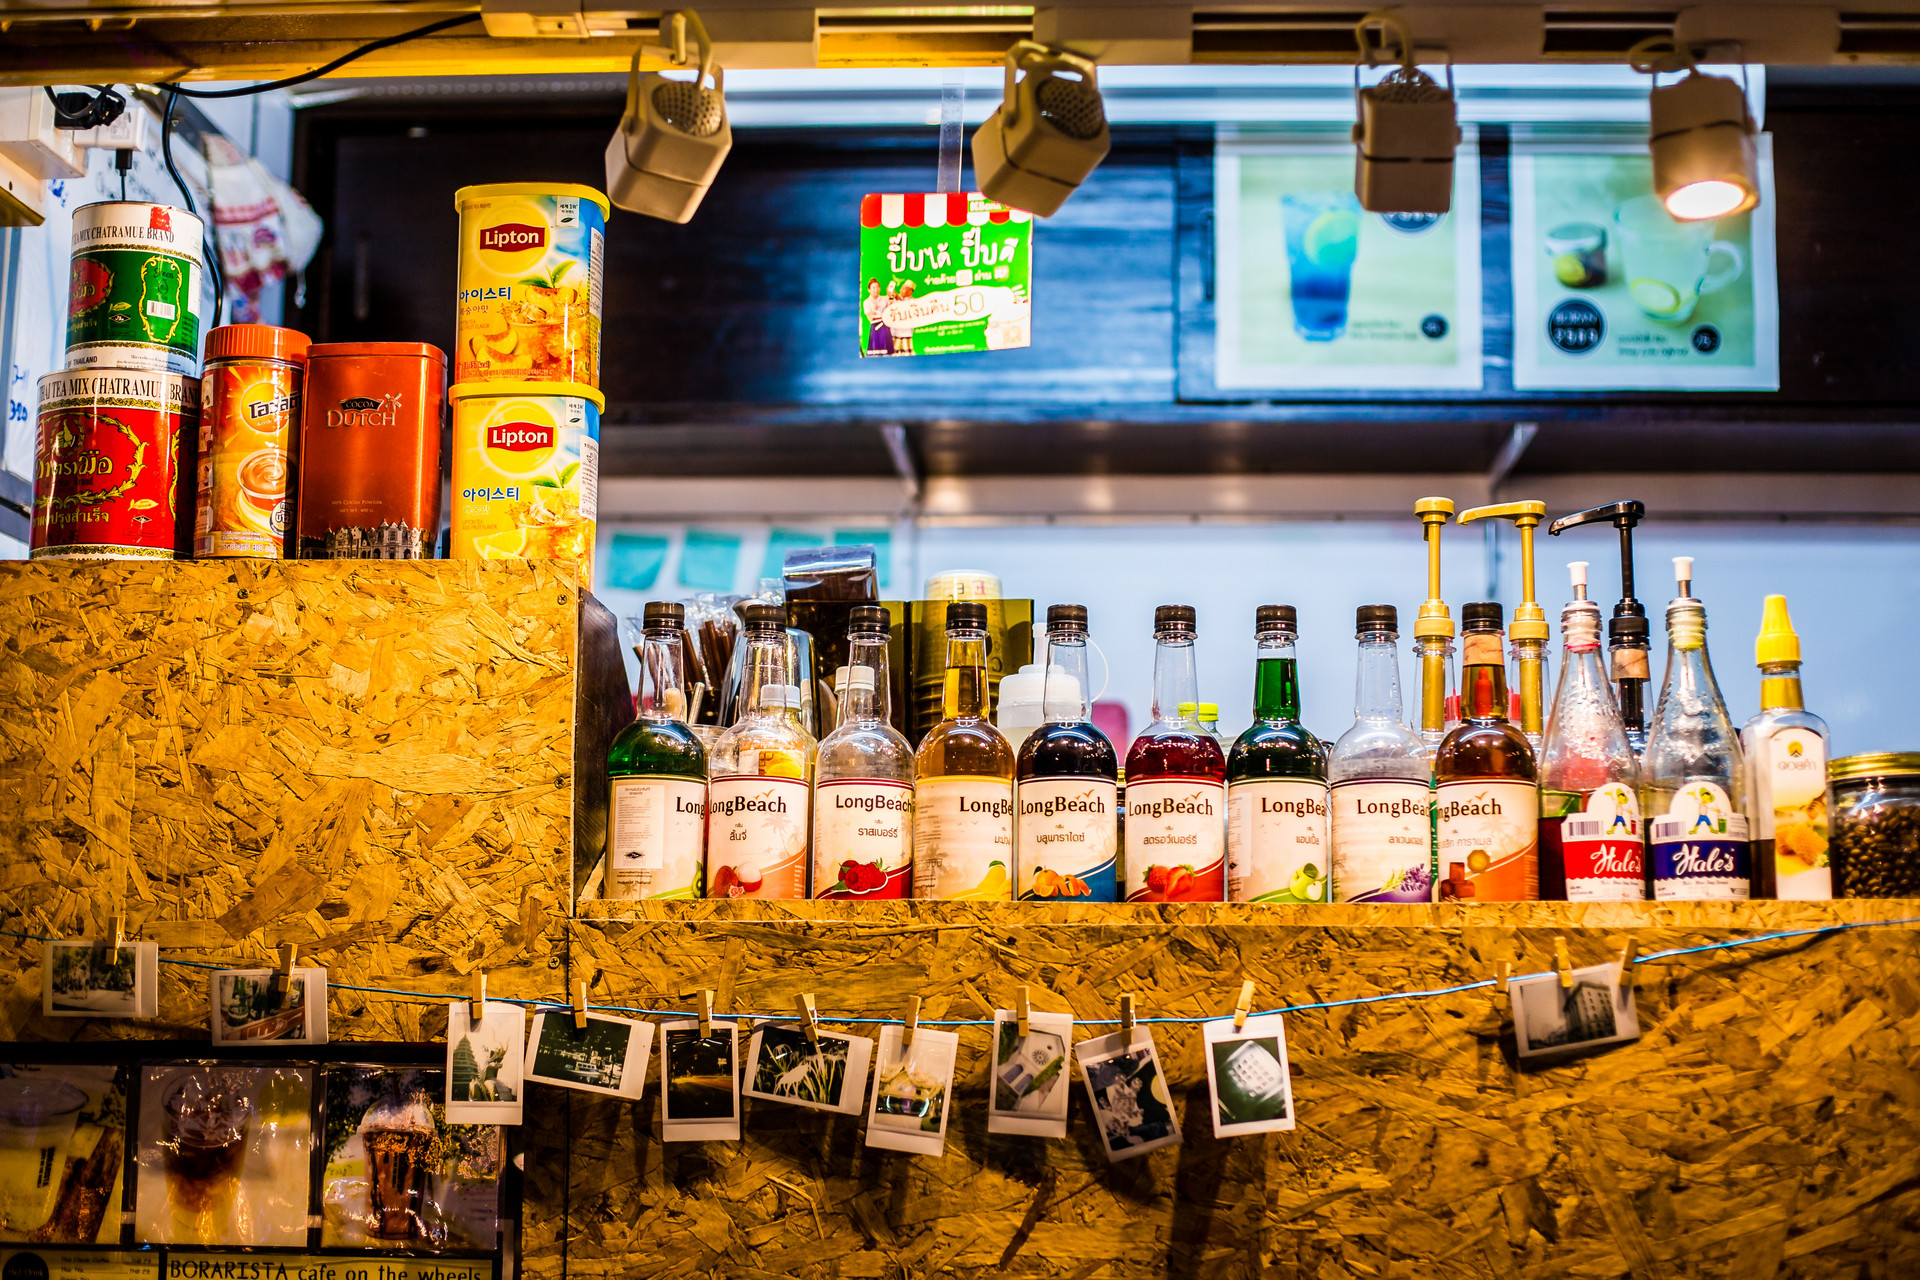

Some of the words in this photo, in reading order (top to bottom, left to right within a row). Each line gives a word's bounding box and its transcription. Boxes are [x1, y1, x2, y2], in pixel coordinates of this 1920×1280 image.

[91, 225, 144, 240] CHATRAMUE
[484, 231, 540, 248] Lipton
[459, 287, 511, 303] 아이스티
[954, 292, 985, 316] 50
[73, 356, 98, 365] THAILAND
[52, 380, 67, 399] TEA
[69, 378, 89, 396] MIX
[327, 410, 396, 428] DUTCH
[492, 428, 548, 447] Lipton
[463, 487, 519, 502] 아이스티
[252, 543, 263, 552] 400
[836, 794, 912, 813] LongBeach
[1021, 796, 1105, 817] LongBeach
[1129, 797, 1213, 818] LongBeach
[1590, 843, 1642, 875] Hale's
[1672, 844, 1735, 875] Hale's
[170, 1260, 288, 1280] BORARISTA
[298, 1264, 336, 1280] cafe
[346, 1268, 368, 1280] on
[378, 1265, 408, 1280] the
[418, 1266, 481, 1280] wheels
